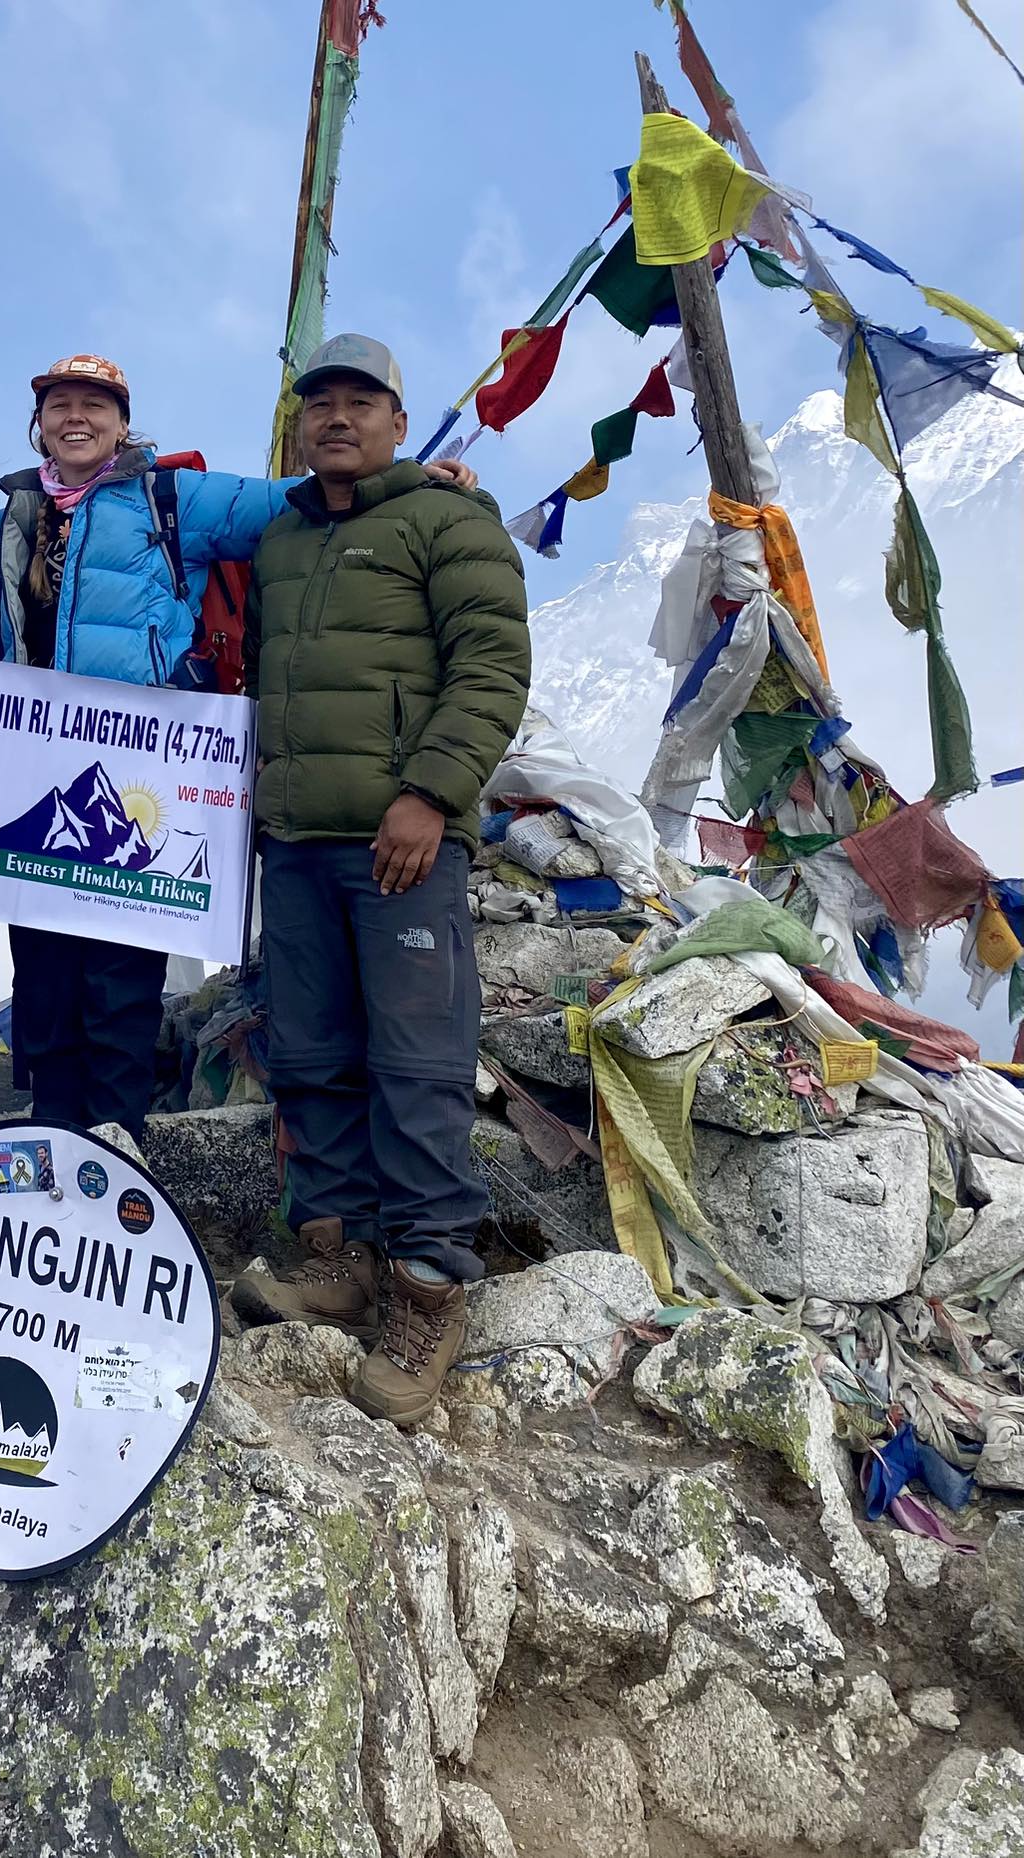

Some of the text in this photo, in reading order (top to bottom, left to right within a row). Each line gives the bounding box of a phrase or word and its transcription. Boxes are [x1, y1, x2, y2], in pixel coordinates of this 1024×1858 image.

[28, 697, 53, 742] RI,
[59, 703, 160, 752] LANGTANG
[163, 720, 249, 774] (4,773m.)
[178, 784, 249, 810] we made it
[72, 890, 200, 922] Your Hiking Guide in Himalaya
[397, 933, 423, 942] NORTH
[407, 927, 423, 936] THE
[404, 940, 423, 948] FACE
[124, 1201, 148, 1213] TRAIL
[121, 1209, 151, 1222] MANDU
[142, 1254, 194, 1325] RI
[53, 1319, 82, 1354] M
[84, 1355, 104, 1365] לוחם
